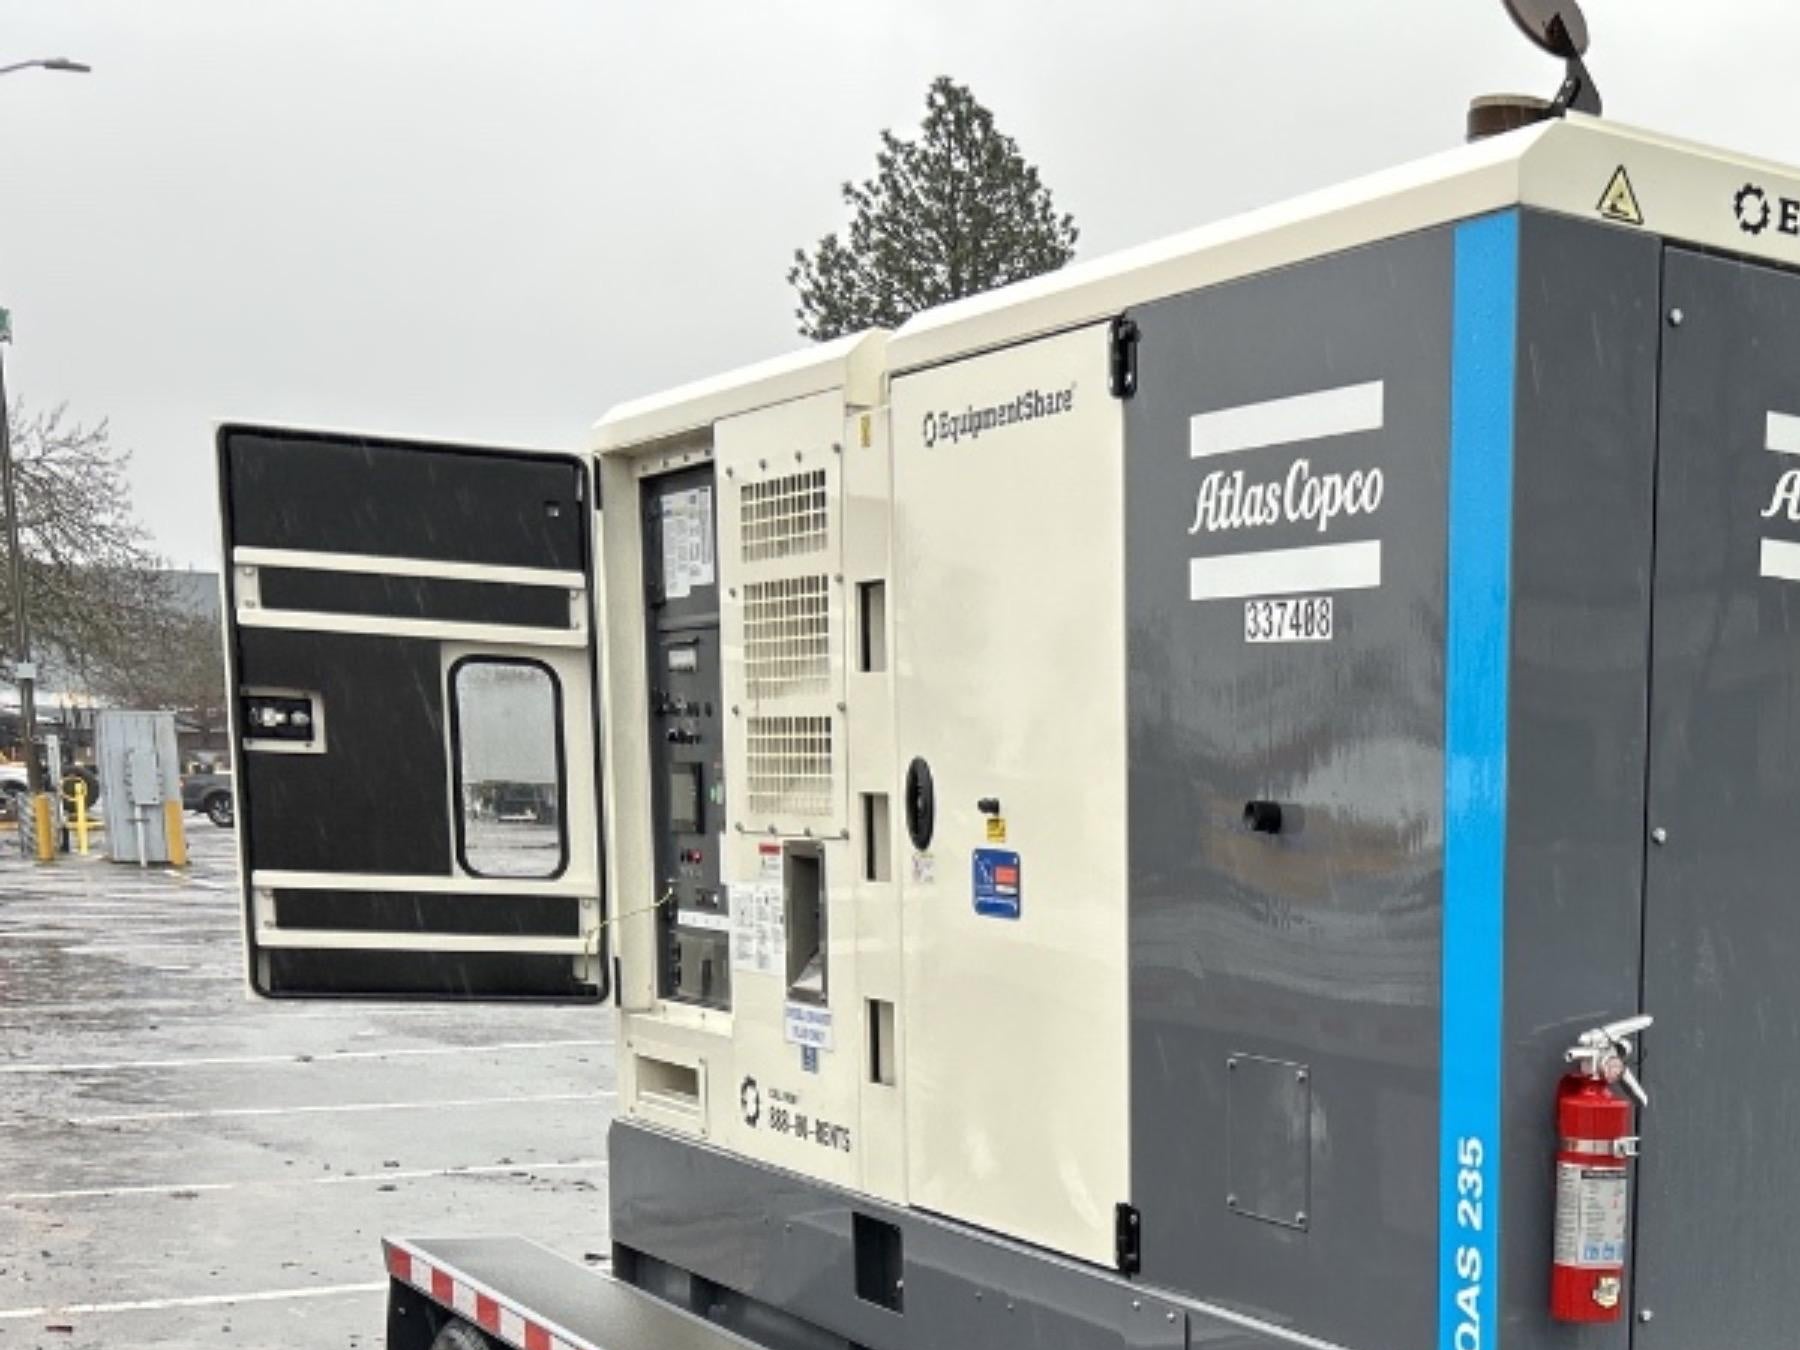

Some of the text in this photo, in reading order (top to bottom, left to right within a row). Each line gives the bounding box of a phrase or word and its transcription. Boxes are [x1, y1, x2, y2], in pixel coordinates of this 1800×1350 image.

[1187, 458, 1385, 535] Atlas Copco
[1246, 598, 1332, 641] 337408
[1457, 1135, 1485, 1233] 235
